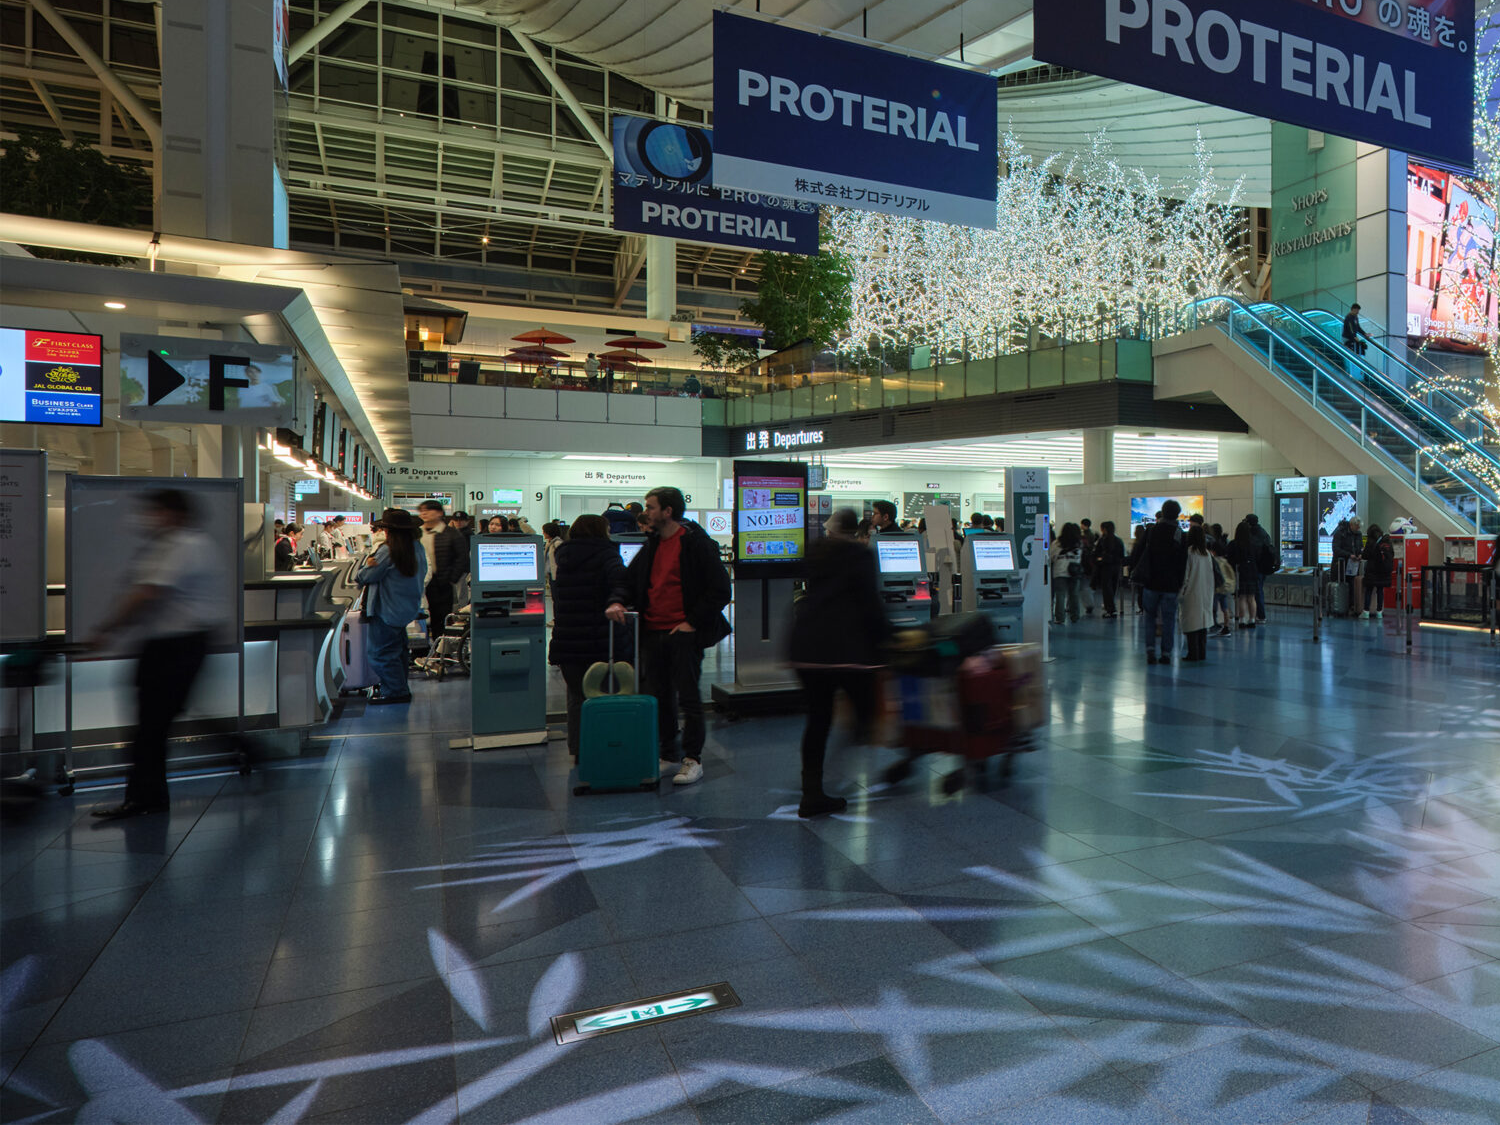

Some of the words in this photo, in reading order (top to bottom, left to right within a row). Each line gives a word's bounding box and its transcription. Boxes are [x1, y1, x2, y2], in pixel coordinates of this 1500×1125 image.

[738, 68, 979, 152] PROTERIAL
[794, 177, 930, 213] 株式会社プロテリアル
[1291, 188, 1328, 211] SHOPS
[642, 200, 796, 243] PROTERIAL
[1304, 212, 1313, 227] &
[1272, 219, 1352, 257] RESTAURANTS
[209, 354, 250, 410] F
[32, 398, 75, 407] BUSINESS
[746, 430, 769, 450] 出発
[774, 430, 824, 449] Departures
[412, 468, 458, 476] Departures
[469, 491, 484, 501] 10
[535, 492, 543, 502] 9
[684, 494, 692, 503] 8
[893, 497, 899, 506] 6
[965, 498, 970, 506] 5
[746, 514, 773, 527] NO!
